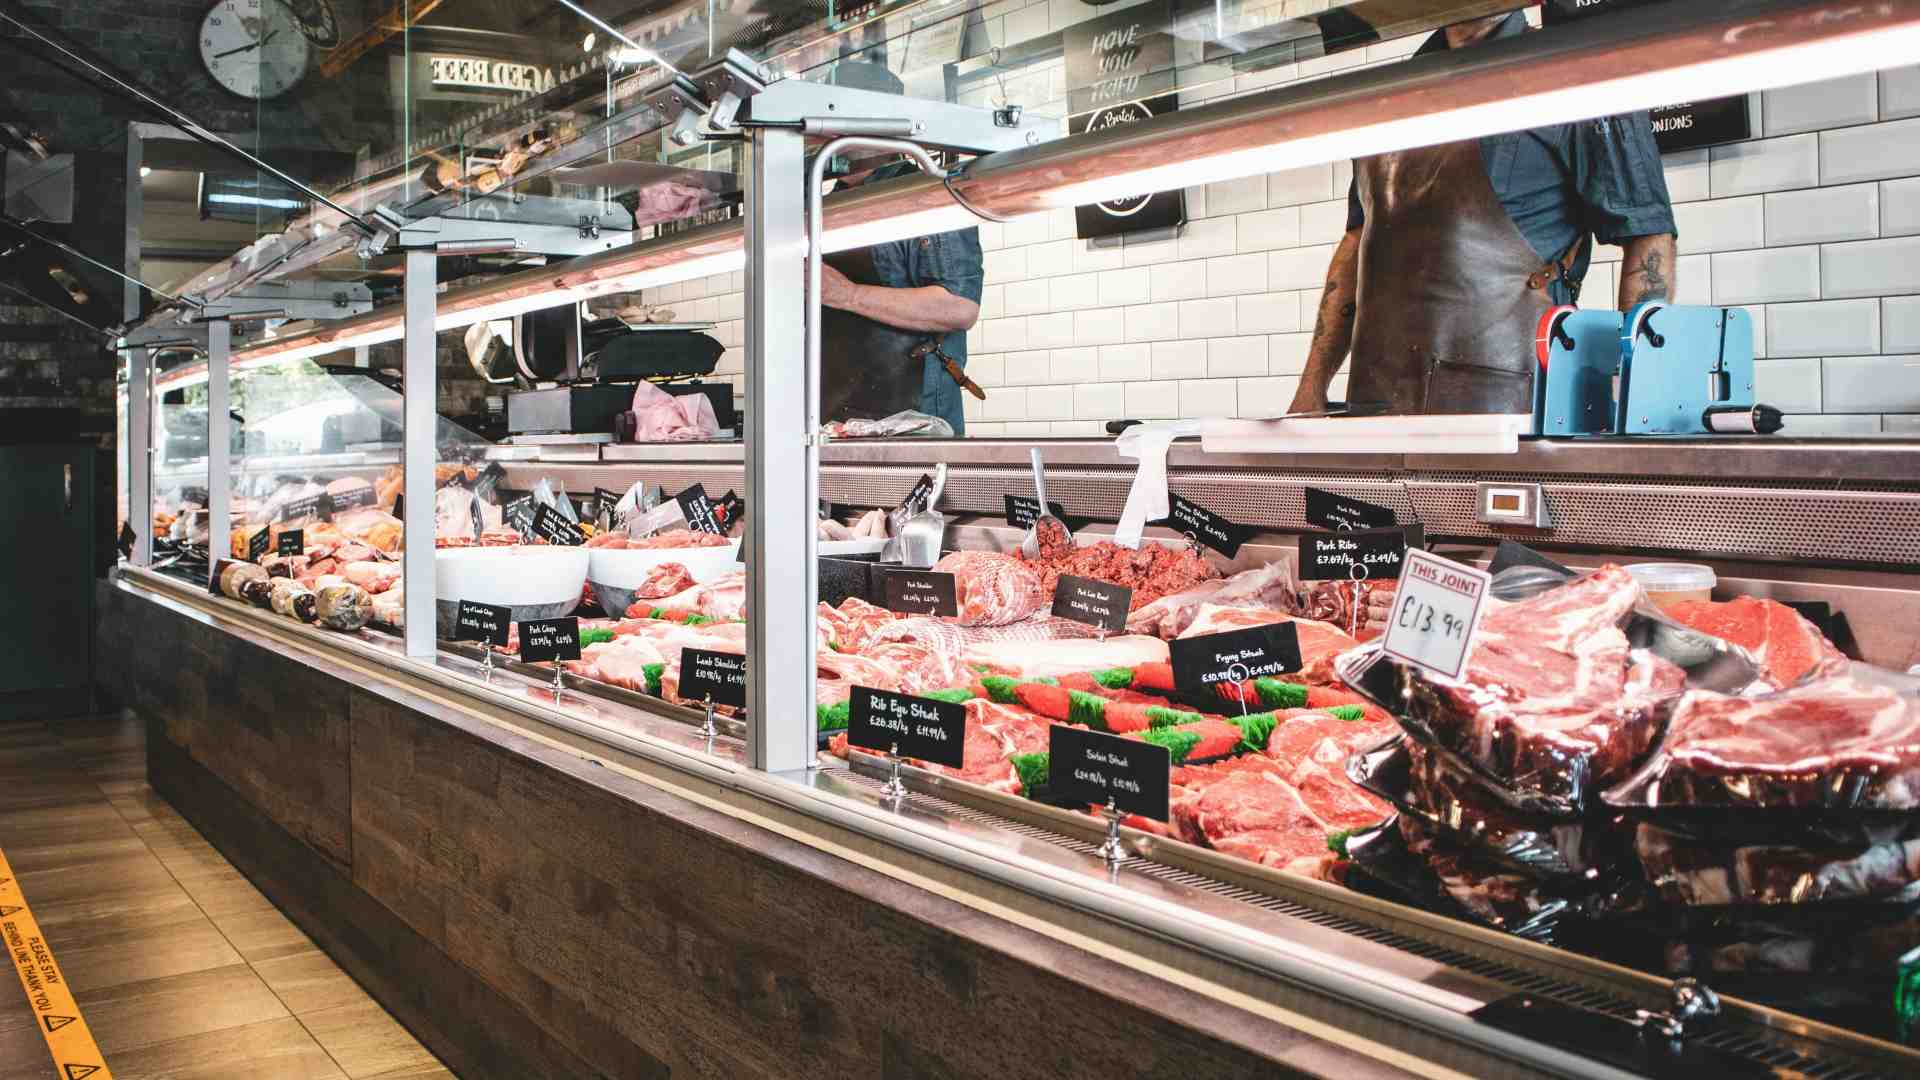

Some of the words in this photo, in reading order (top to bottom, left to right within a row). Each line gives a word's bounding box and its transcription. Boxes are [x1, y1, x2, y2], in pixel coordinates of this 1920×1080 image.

[1091, 24, 1139, 54] HAVE
[1100, 50, 1135, 75] YOU
[1316, 540, 1336, 551] Pork
[1338, 539, 1358, 550] Ribs
[1413, 562, 1439, 580] THIS
[1440, 573, 1478, 594] JOINT
[1240, 647, 1265, 659] Steak
[870, 694, 888, 711] Rib
[889, 699, 909, 718] Eye
[910, 703, 940, 721] Steak
[1108, 752, 1129, 767] Steak
[4, 921, 23, 947] BEHIND
[14, 946, 32, 965] LINE
[29, 936, 50, 966] PLEASE
[41, 964, 61, 985] STAY
[22, 964, 43, 992] THANK
[33, 992, 53, 1011] YOU
